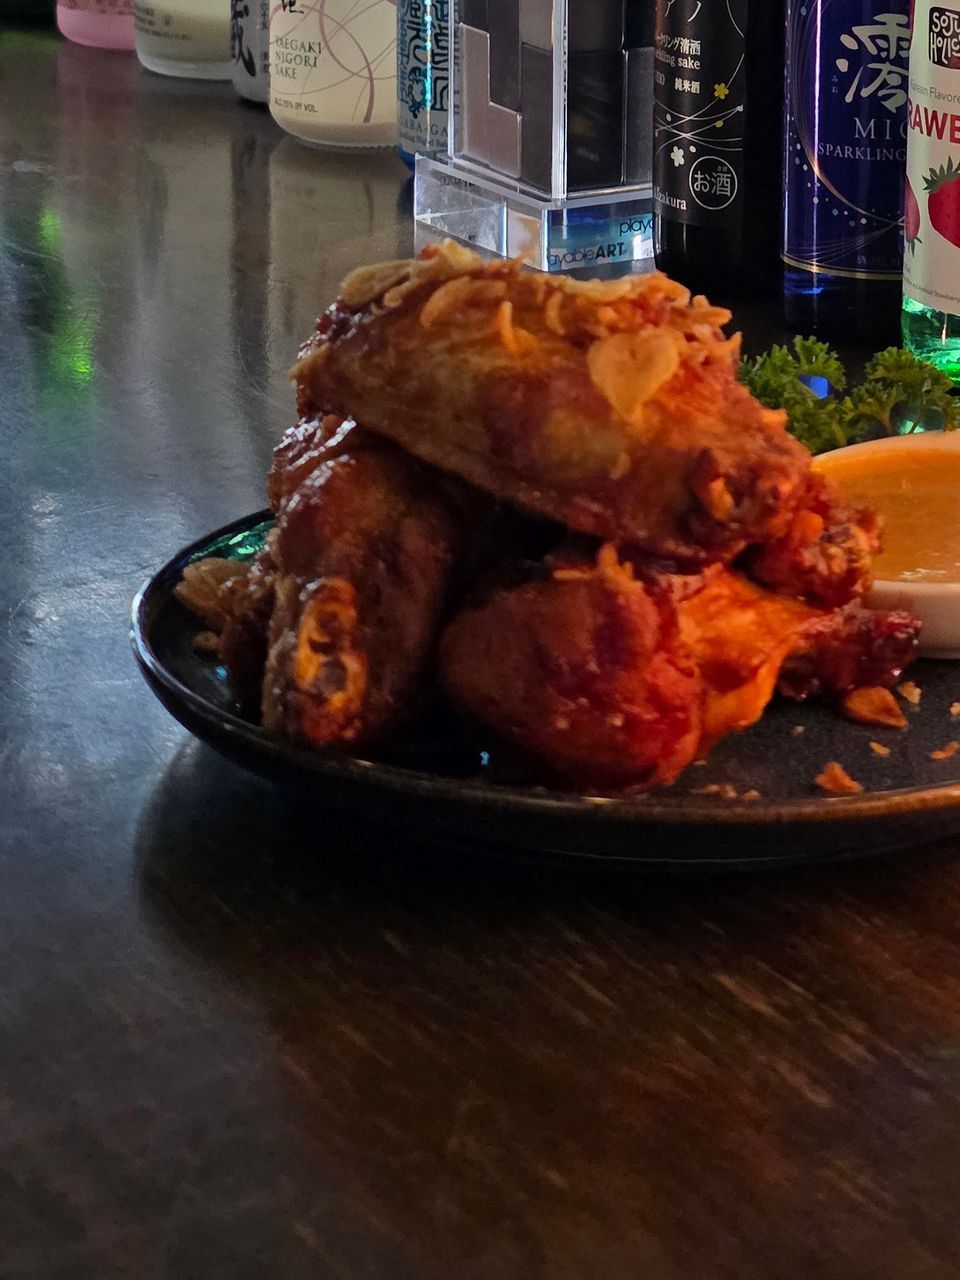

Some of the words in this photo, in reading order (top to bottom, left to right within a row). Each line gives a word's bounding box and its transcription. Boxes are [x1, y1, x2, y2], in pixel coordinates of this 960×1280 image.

[275, 35, 322, 55] YAEGAKI
[275, 51, 318, 68] NIGORI
[677, 57, 701, 70] sake
[275, 64, 297, 80] SAKE
[674, 77, 701, 95] 純米酒
[693, 170, 733, 198] お酒
